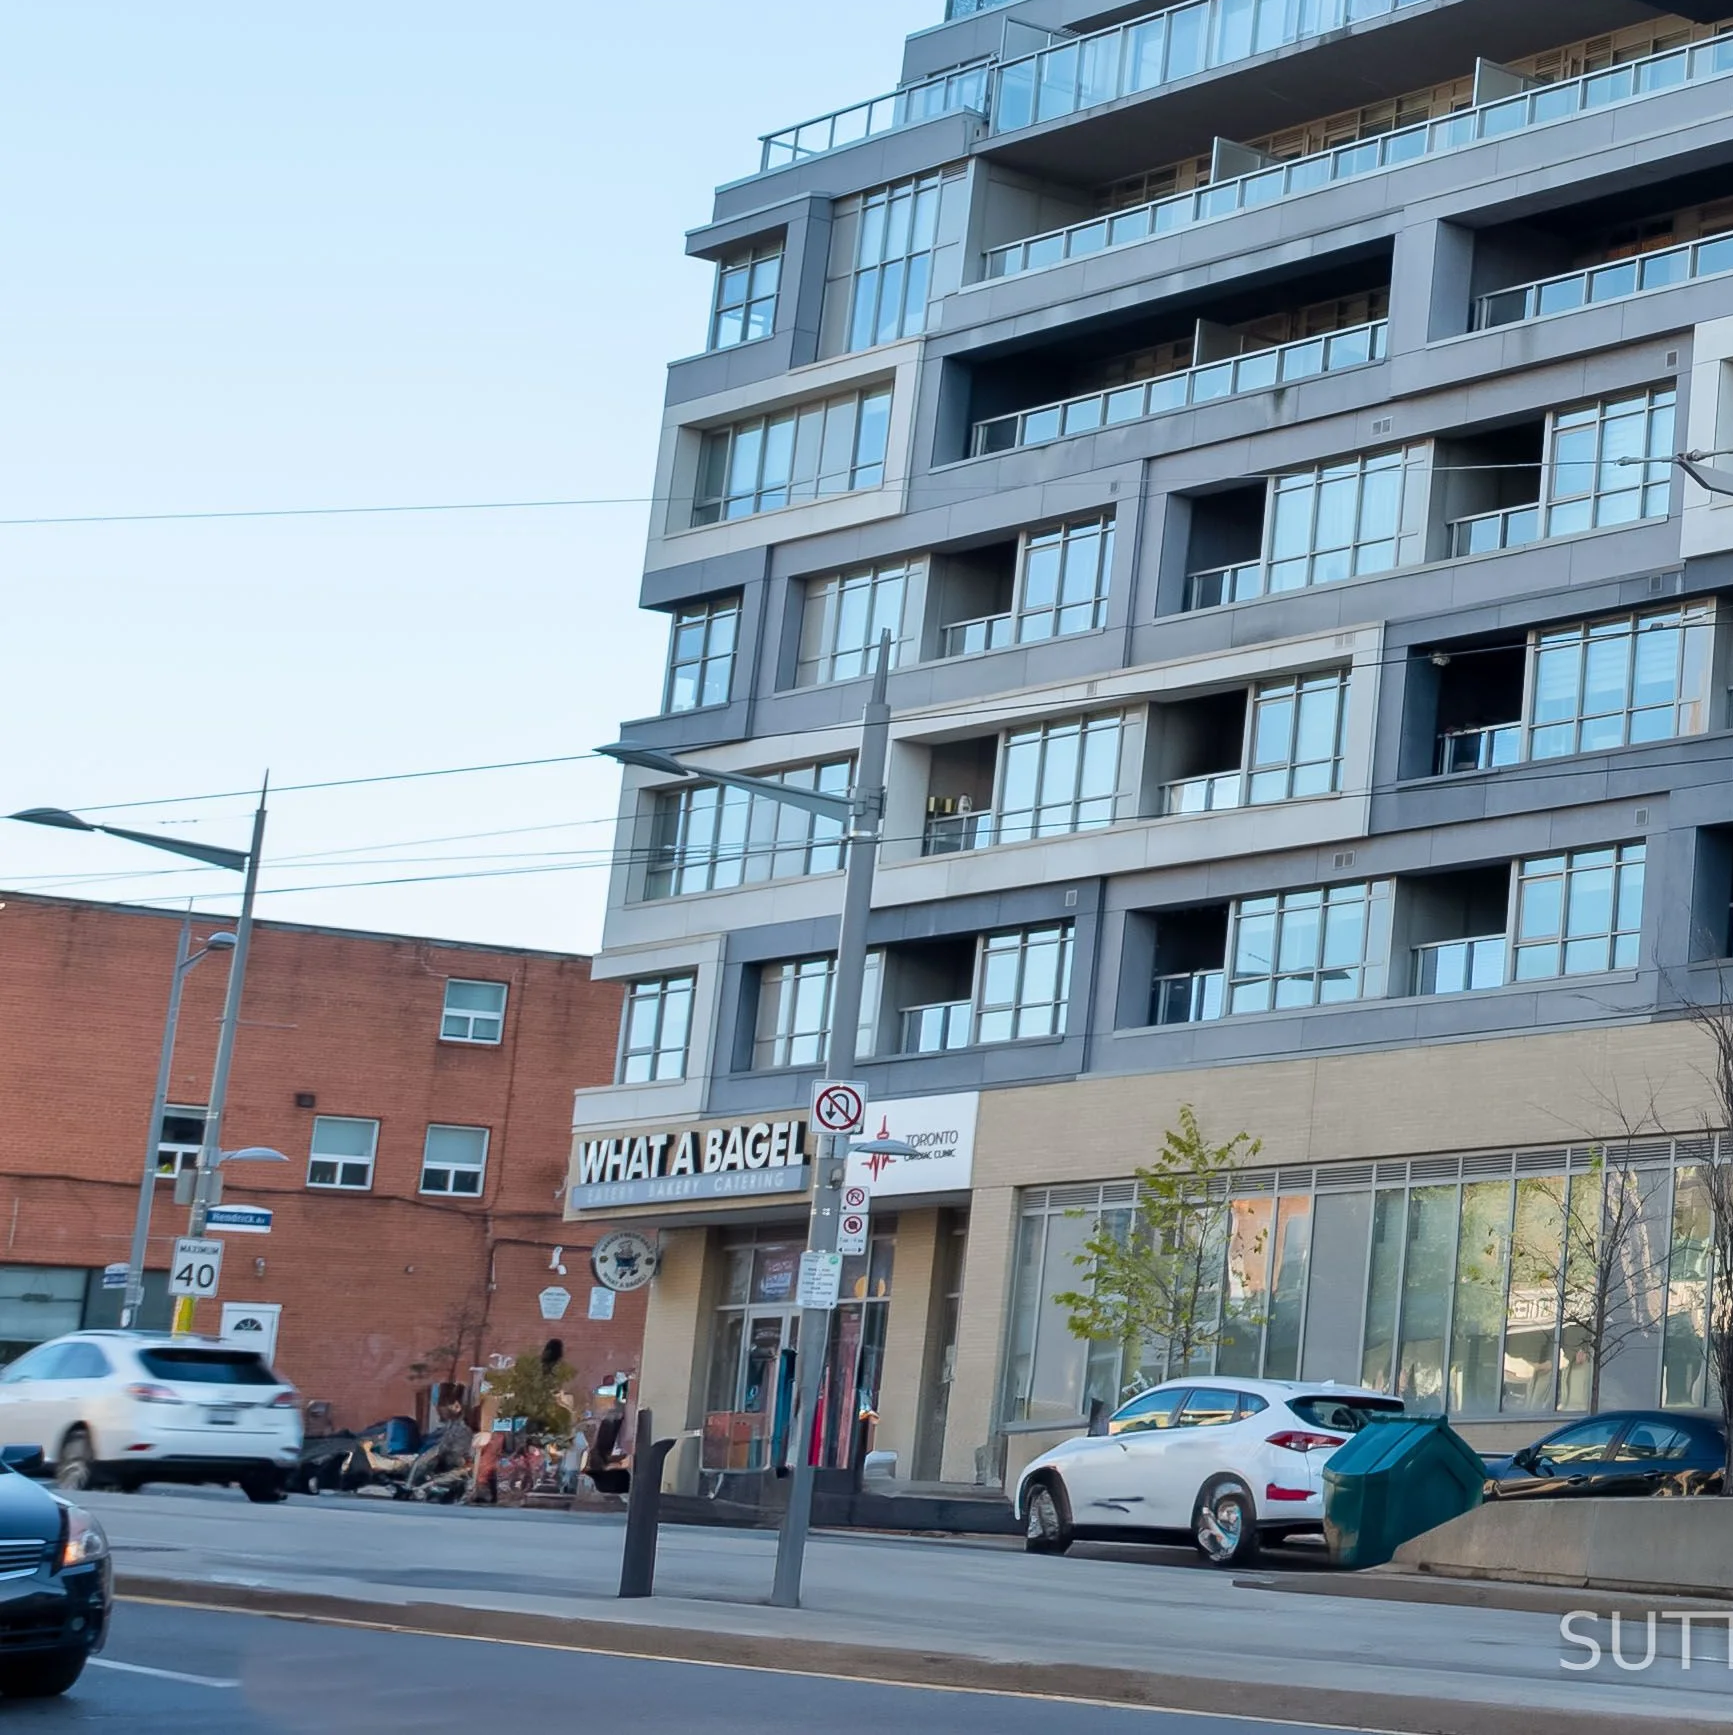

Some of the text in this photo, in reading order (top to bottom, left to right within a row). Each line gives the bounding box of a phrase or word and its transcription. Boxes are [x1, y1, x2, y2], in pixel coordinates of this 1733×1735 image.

[905, 1130, 958, 1148] TORONTO
[579, 1120, 806, 1185] WHAT A BAGEL
[713, 1172, 785, 1192] CATERING
[180, 1245, 220, 1255] MAXIMUM
[175, 1263, 215, 1288] 40
